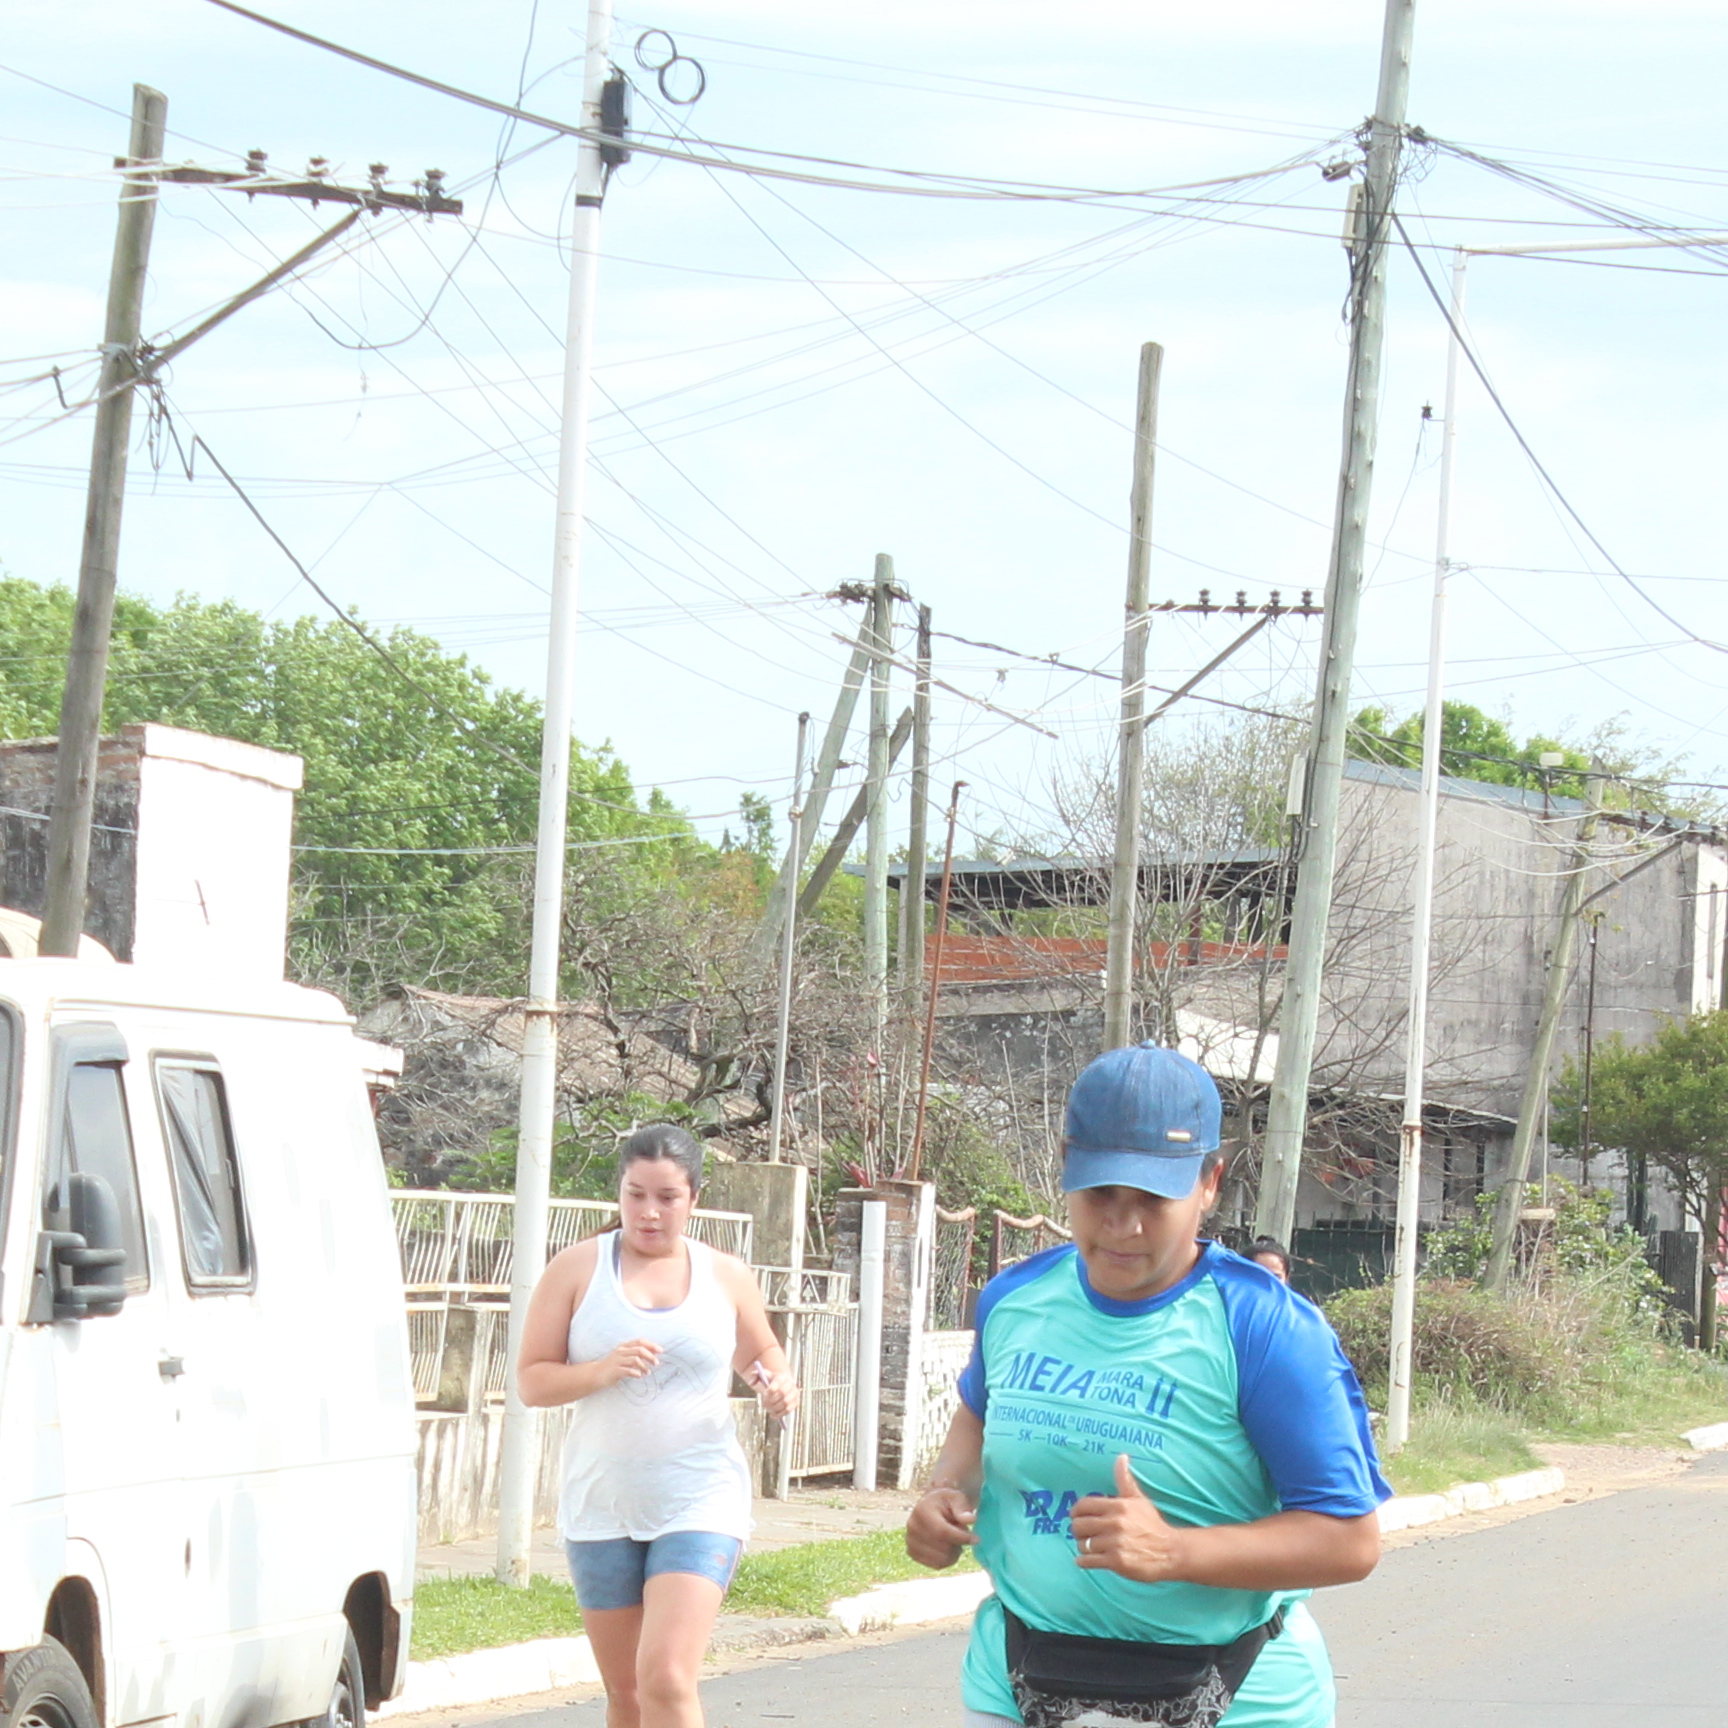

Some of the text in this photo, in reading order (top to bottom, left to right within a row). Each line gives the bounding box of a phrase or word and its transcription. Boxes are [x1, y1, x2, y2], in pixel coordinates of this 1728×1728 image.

[1000, 1352, 1096, 1399] MEIA
[1098, 1371, 1145, 1392] MARA
[1091, 1386, 1136, 1409] TONA
[1017, 1429, 1032, 1442] 5K
[1083, 1440, 1105, 1455] 21K
[1076, 1416, 1164, 1450] URUGUAIANA
